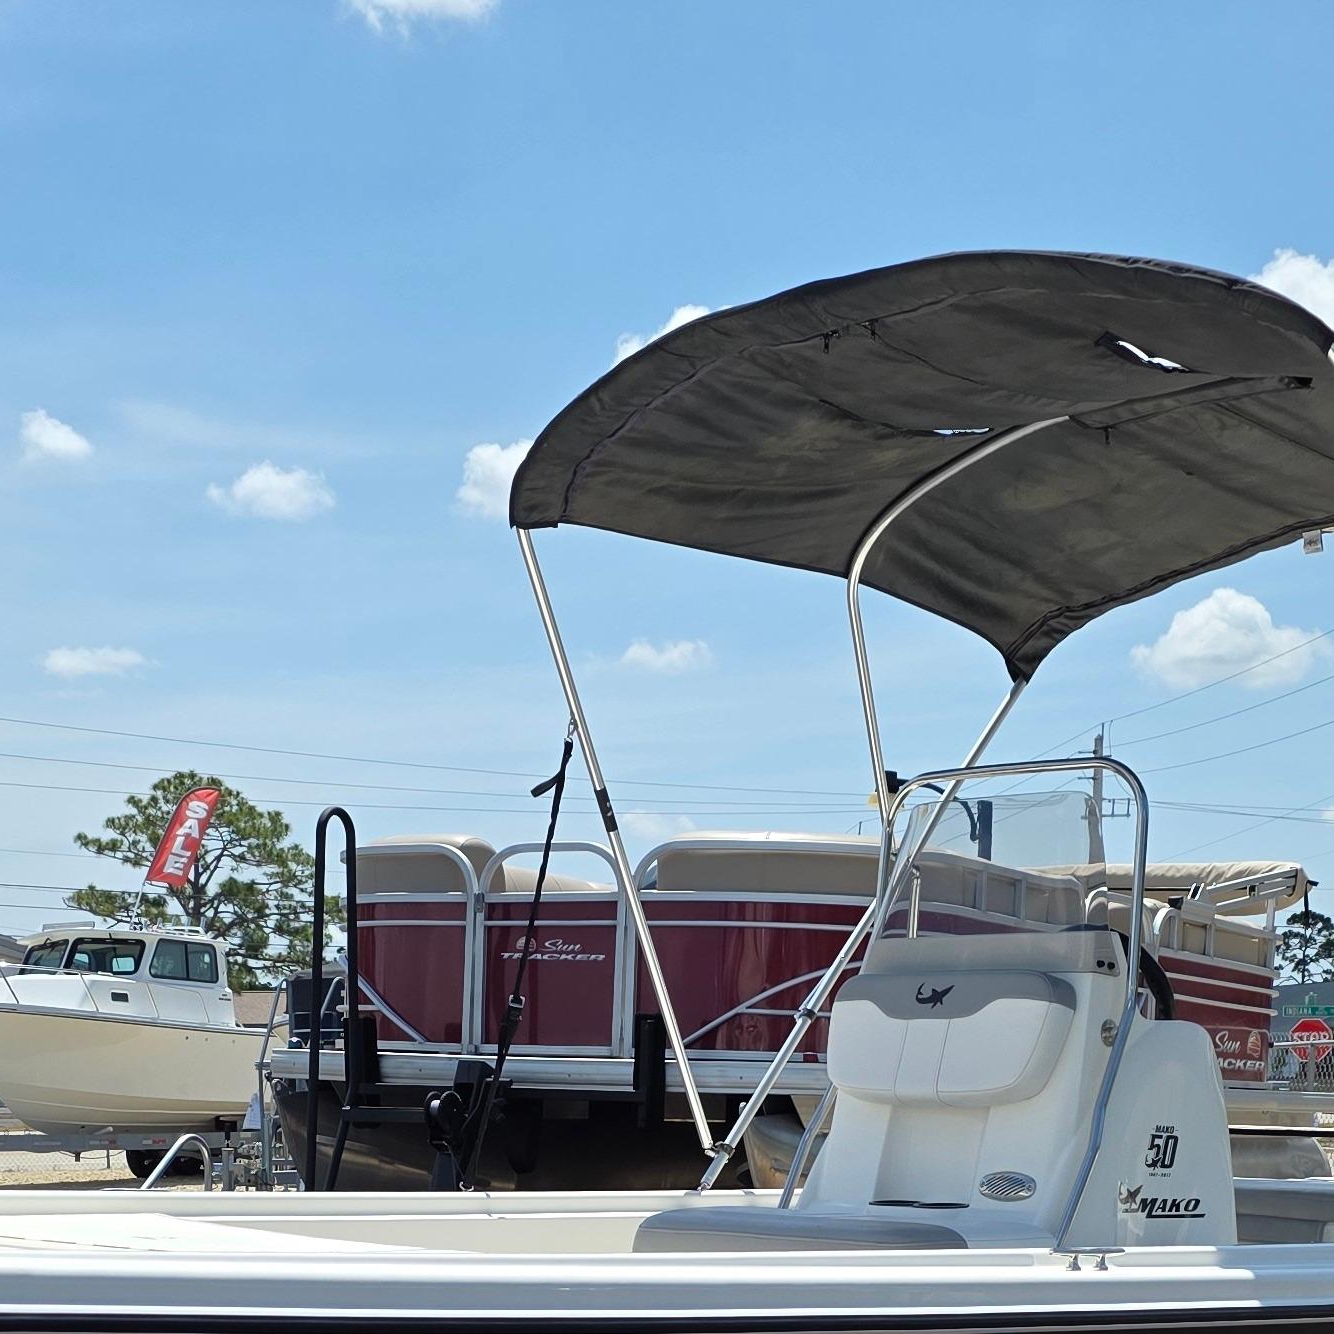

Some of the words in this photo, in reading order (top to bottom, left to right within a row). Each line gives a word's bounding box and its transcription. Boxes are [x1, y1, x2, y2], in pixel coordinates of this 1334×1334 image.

[163, 800, 209, 876] SALE
[1215, 1031, 1241, 1053] Sun
[1293, 1031, 1329, 1042] STOP
[1217, 1058, 1265, 1071] ACKER
[1155, 1124, 1175, 1134] MAKO
[1145, 1134, 1179, 1170] 50
[1138, 1197, 1206, 1219] MAKO
